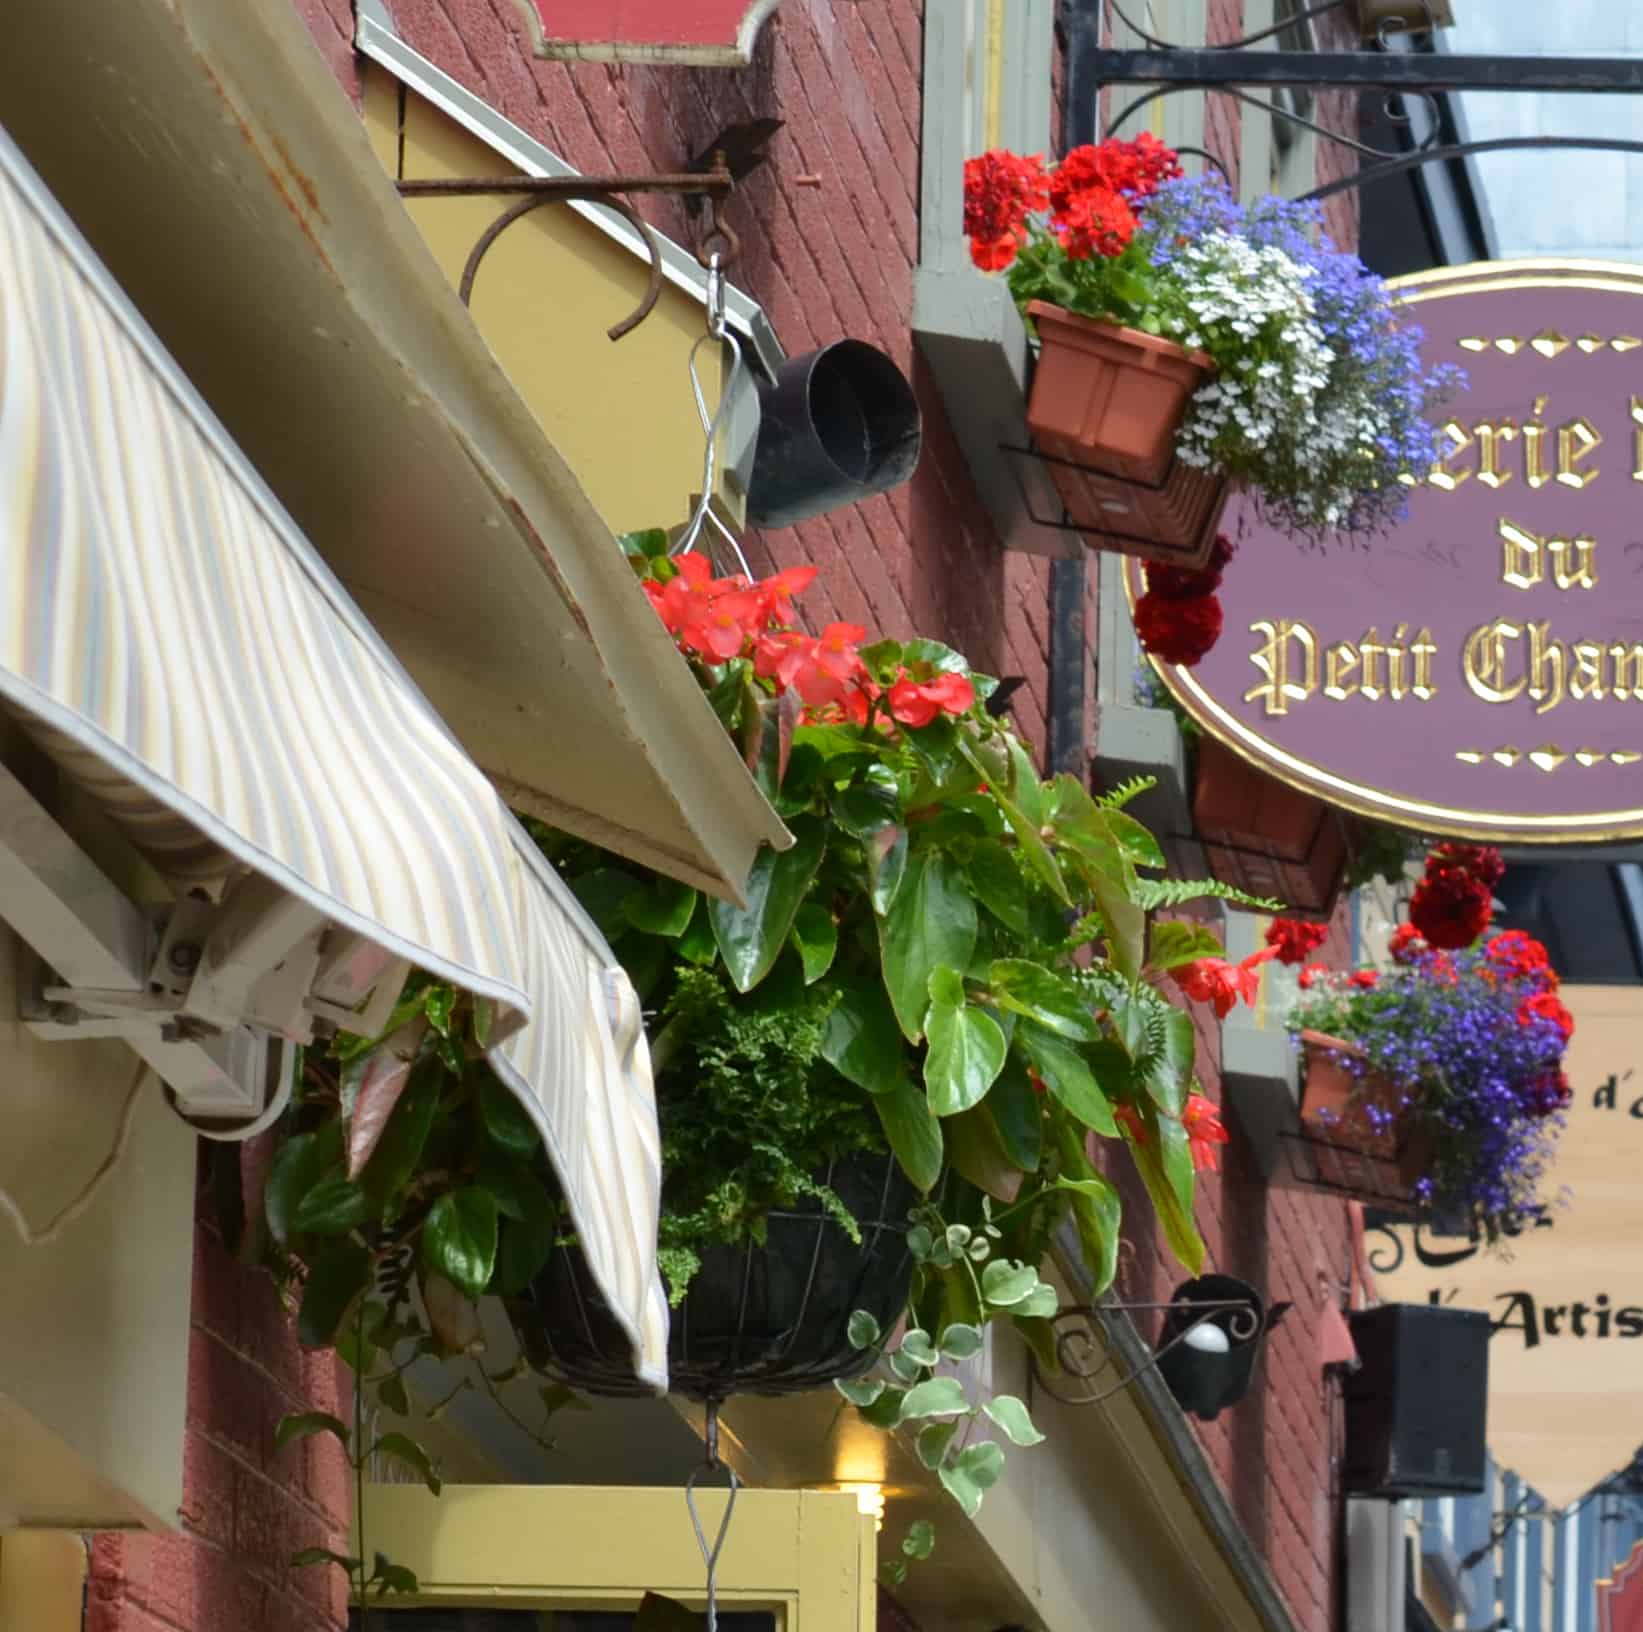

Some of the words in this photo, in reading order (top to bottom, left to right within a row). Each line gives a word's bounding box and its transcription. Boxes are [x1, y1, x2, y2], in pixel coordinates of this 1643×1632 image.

[1397, 394, 1602, 490] erie
[1498, 517, 1599, 590] du
[1244, 618, 1437, 717] Petit
